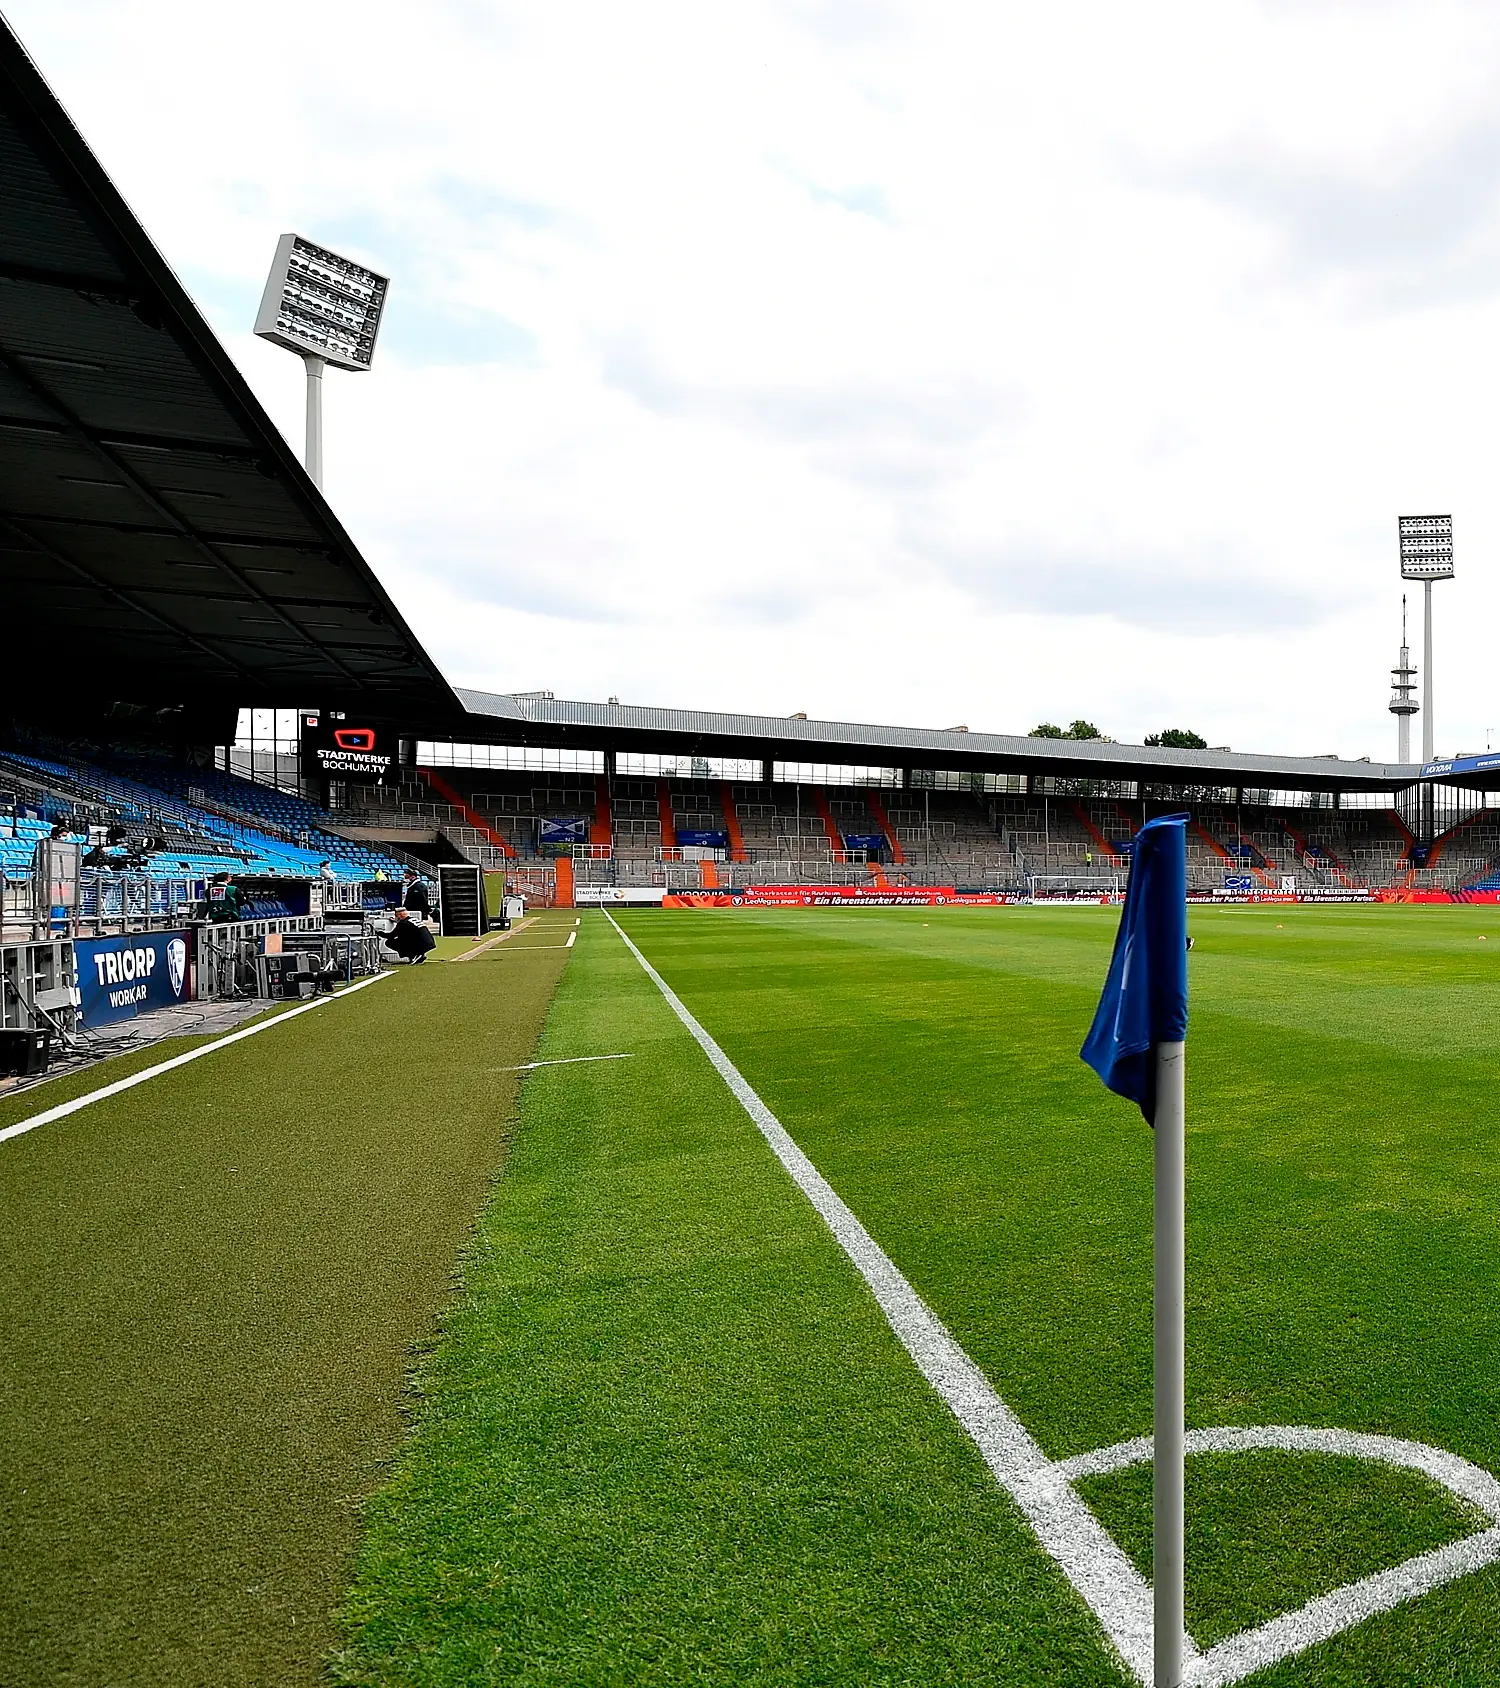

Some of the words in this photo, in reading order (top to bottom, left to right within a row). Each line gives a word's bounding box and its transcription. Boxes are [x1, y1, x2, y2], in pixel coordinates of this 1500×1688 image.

[317, 749, 391, 765] STADTWERKE
[322, 760, 386, 774] BOCHUM.TV
[1425, 763, 1453, 774] VONOVIA
[744, 897, 780, 906] LeoVegas
[813, 896, 829, 905] Ein
[831, 896, 894, 905] löwenstarker
[895, 896, 931, 905] Partner
